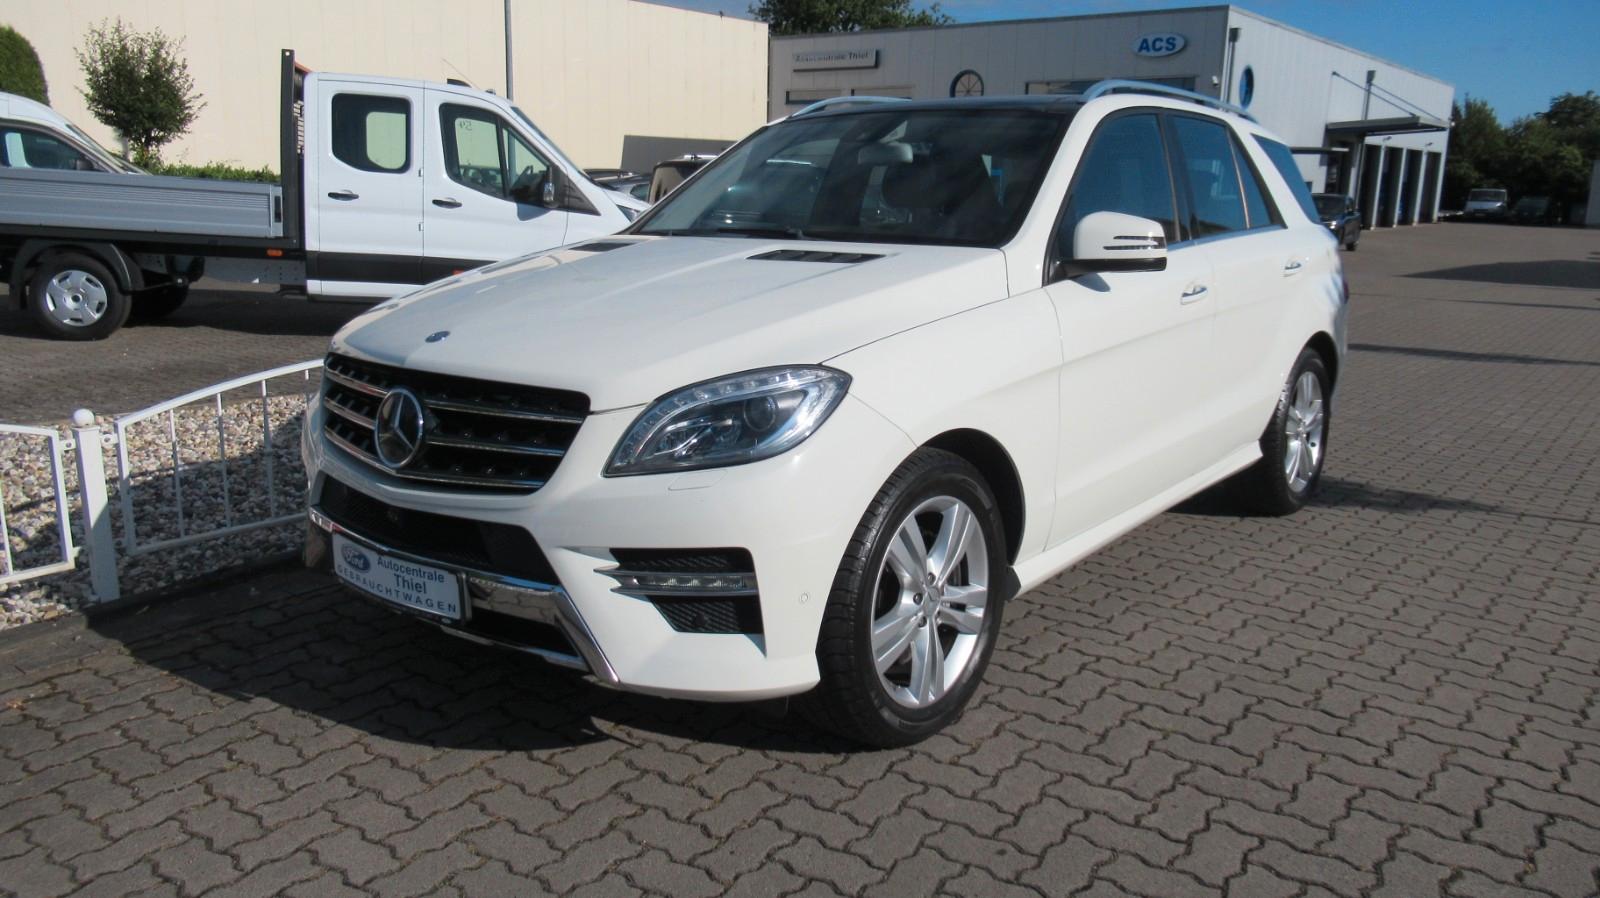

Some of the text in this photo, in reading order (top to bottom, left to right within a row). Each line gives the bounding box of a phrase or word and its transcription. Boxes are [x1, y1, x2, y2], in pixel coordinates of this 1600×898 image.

[1138, 37, 1176, 53] ACS
[378, 556, 445, 583] Autocentrale
[337, 565, 456, 613] GEBRAUCHTWAGEN
[394, 573, 427, 594] Thiel
